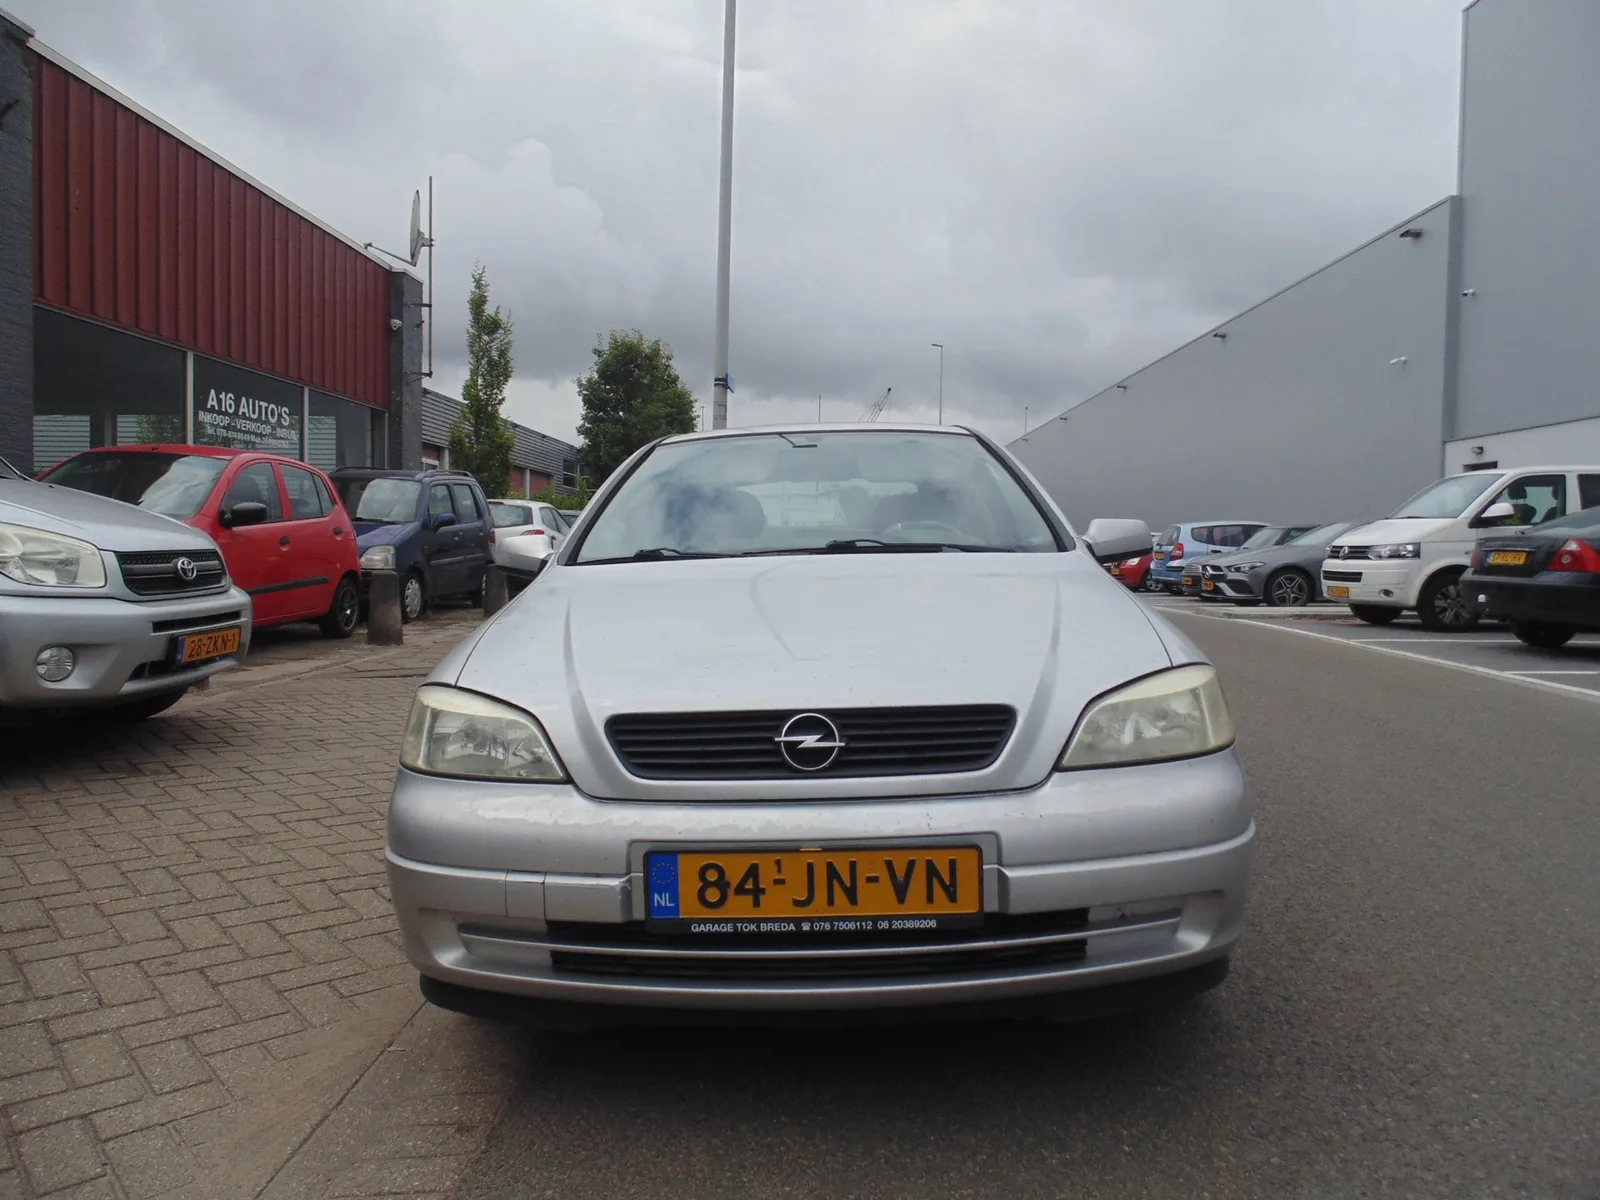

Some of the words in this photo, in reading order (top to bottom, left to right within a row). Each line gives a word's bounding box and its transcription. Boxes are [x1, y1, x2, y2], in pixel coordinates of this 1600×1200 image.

[198, 410, 230, 427] INKOOP
[236, 419, 272, 435] VERKOOP
[238, 396, 290, 426] AUTO'S
[697, 858, 958, 910] 84-JN-VN
[653, 892, 676, 907] NL
[691, 923, 734, 932] GARAGE
[736, 922, 757, 932] TOK
[760, 922, 796, 932] BREDA
[813, 921, 831, 931] 076
[833, 921, 873, 931] 7506112
[877, 920, 889, 930] 06
[891, 919, 937, 930] 20389206
